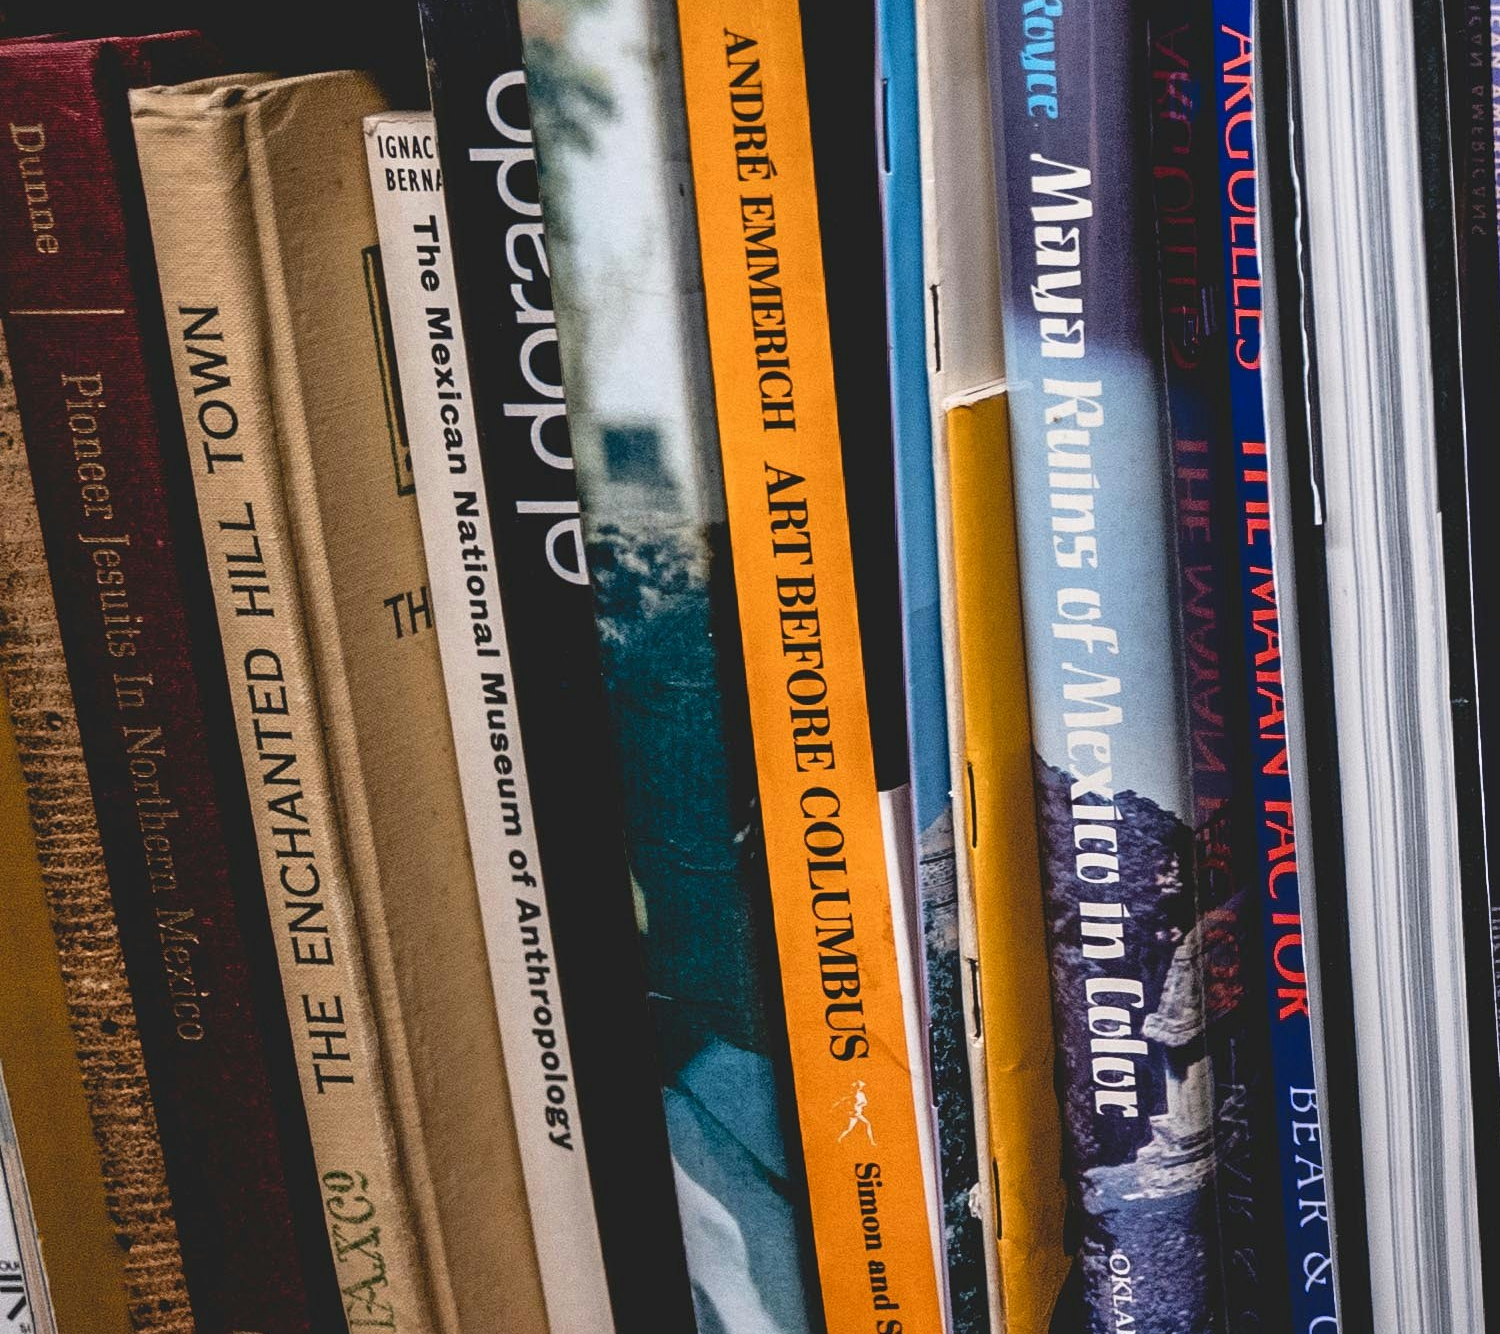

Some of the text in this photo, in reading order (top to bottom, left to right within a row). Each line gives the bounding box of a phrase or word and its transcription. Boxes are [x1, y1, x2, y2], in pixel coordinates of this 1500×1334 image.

[8, 123, 58, 255] Dunne
[724, 28, 797, 433] ANDRÉ EMMERICH
[179, 307, 355, 1093] THE ENCHANTED HILL TOWN
[413, 215, 573, 1153] The Mexican National Museum of Anthropology
[765, 461, 872, 1062] ART BEFORE COLUMBUS
[1030, 153, 1149, 1119] Maya Ruins of Mexico in Color
